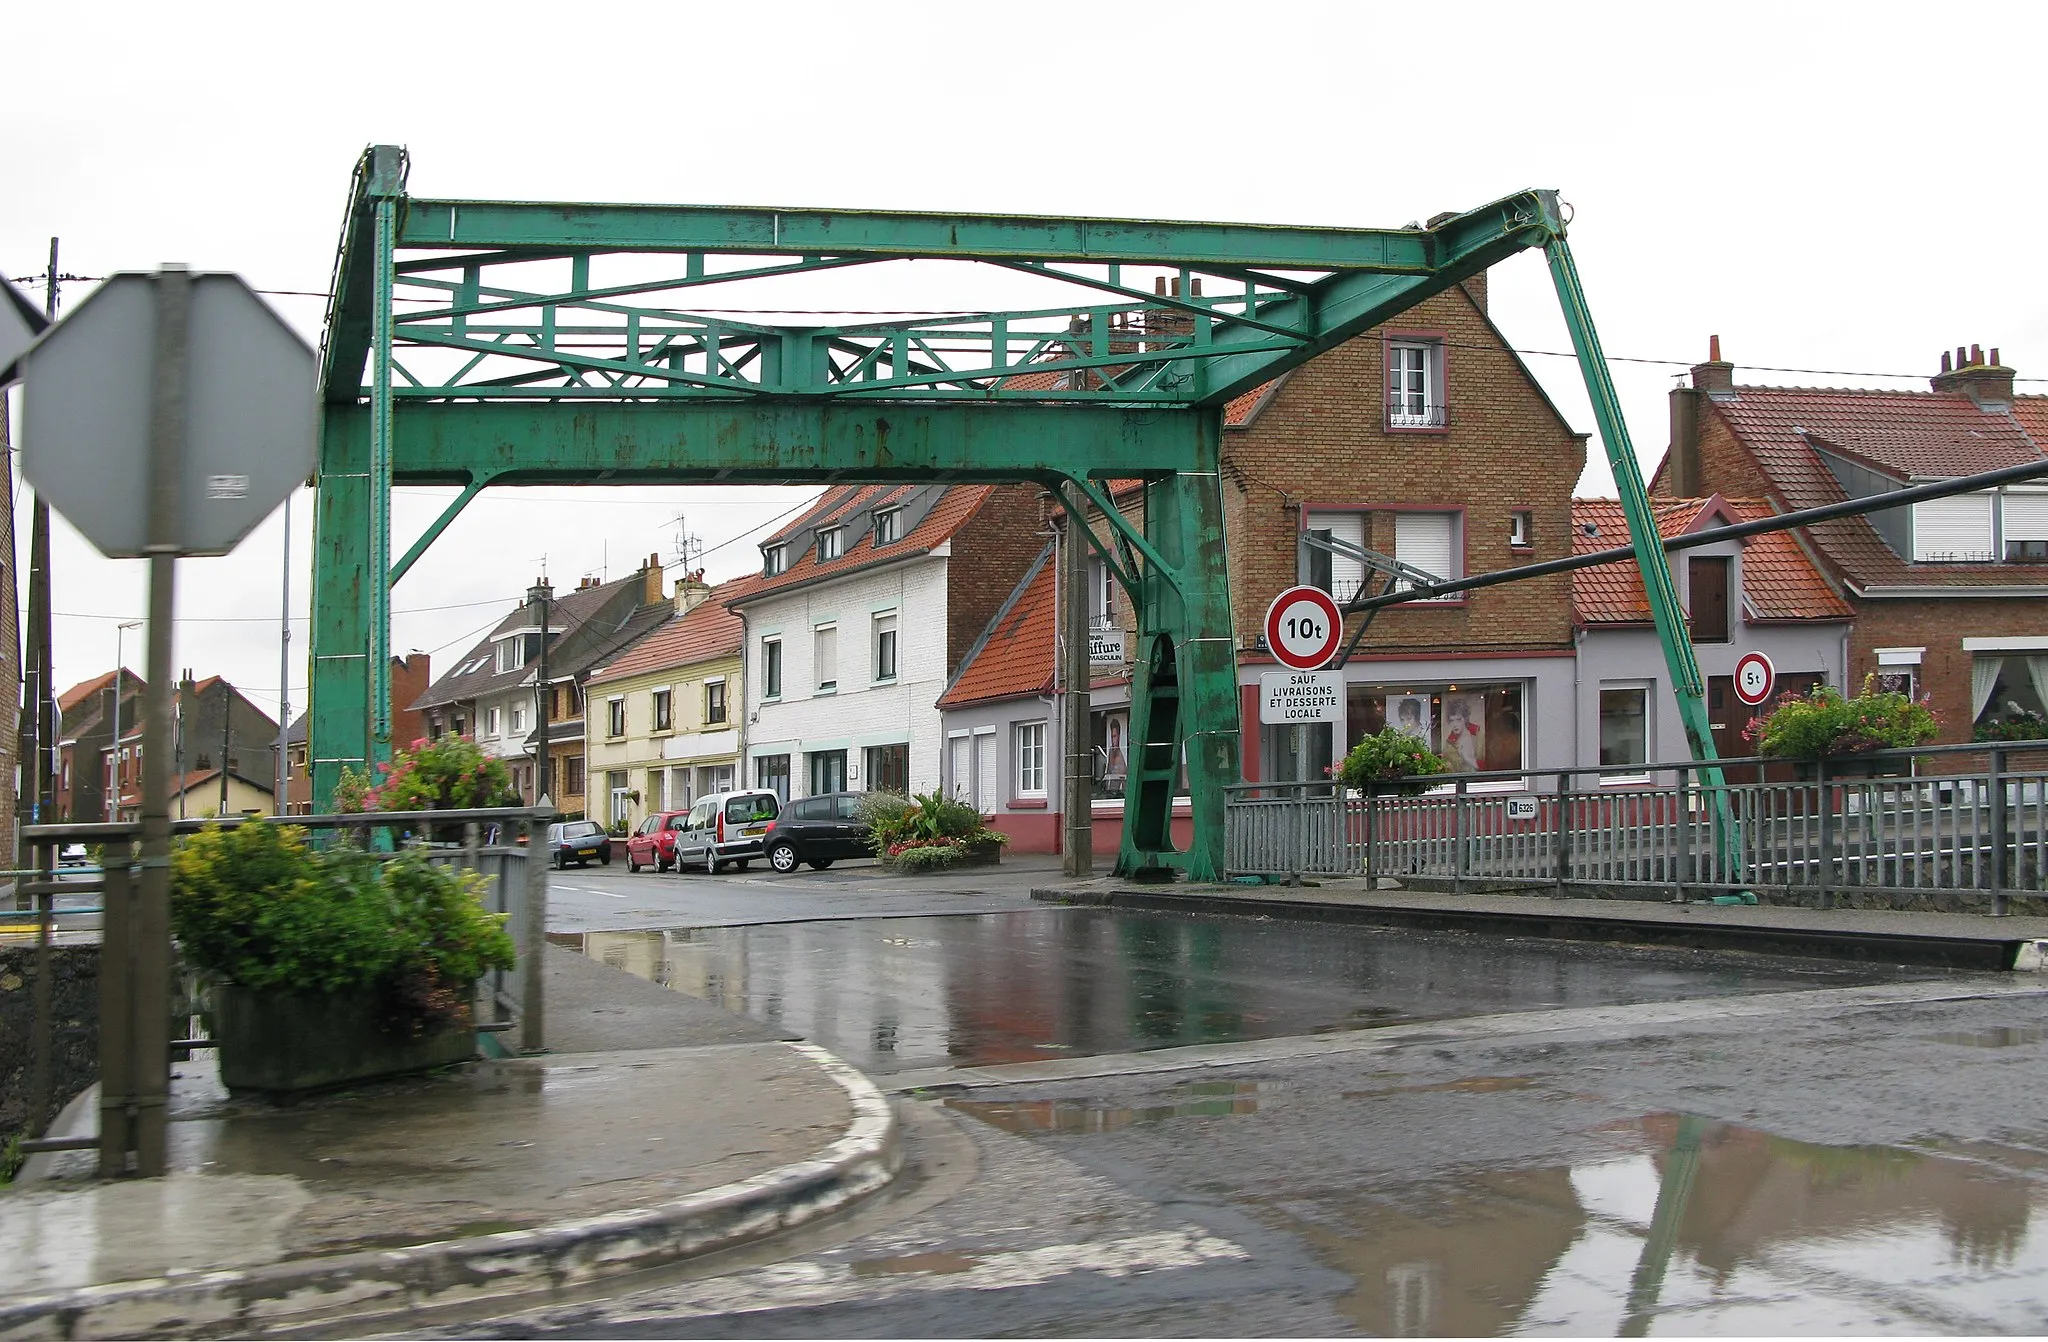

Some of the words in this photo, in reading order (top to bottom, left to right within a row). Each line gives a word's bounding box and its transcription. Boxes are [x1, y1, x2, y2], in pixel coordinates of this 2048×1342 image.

[1089, 641, 1121, 655] iffure
[1290, 675, 1316, 685] SAUF
[1273, 686, 1333, 697] LIVRAISONS
[1270, 699, 1282, 708] ET
[1286, 696, 1337, 707] DESSERTE
[1285, 709, 1321, 718] LOCALE
[1519, 803, 1534, 813] 6326
